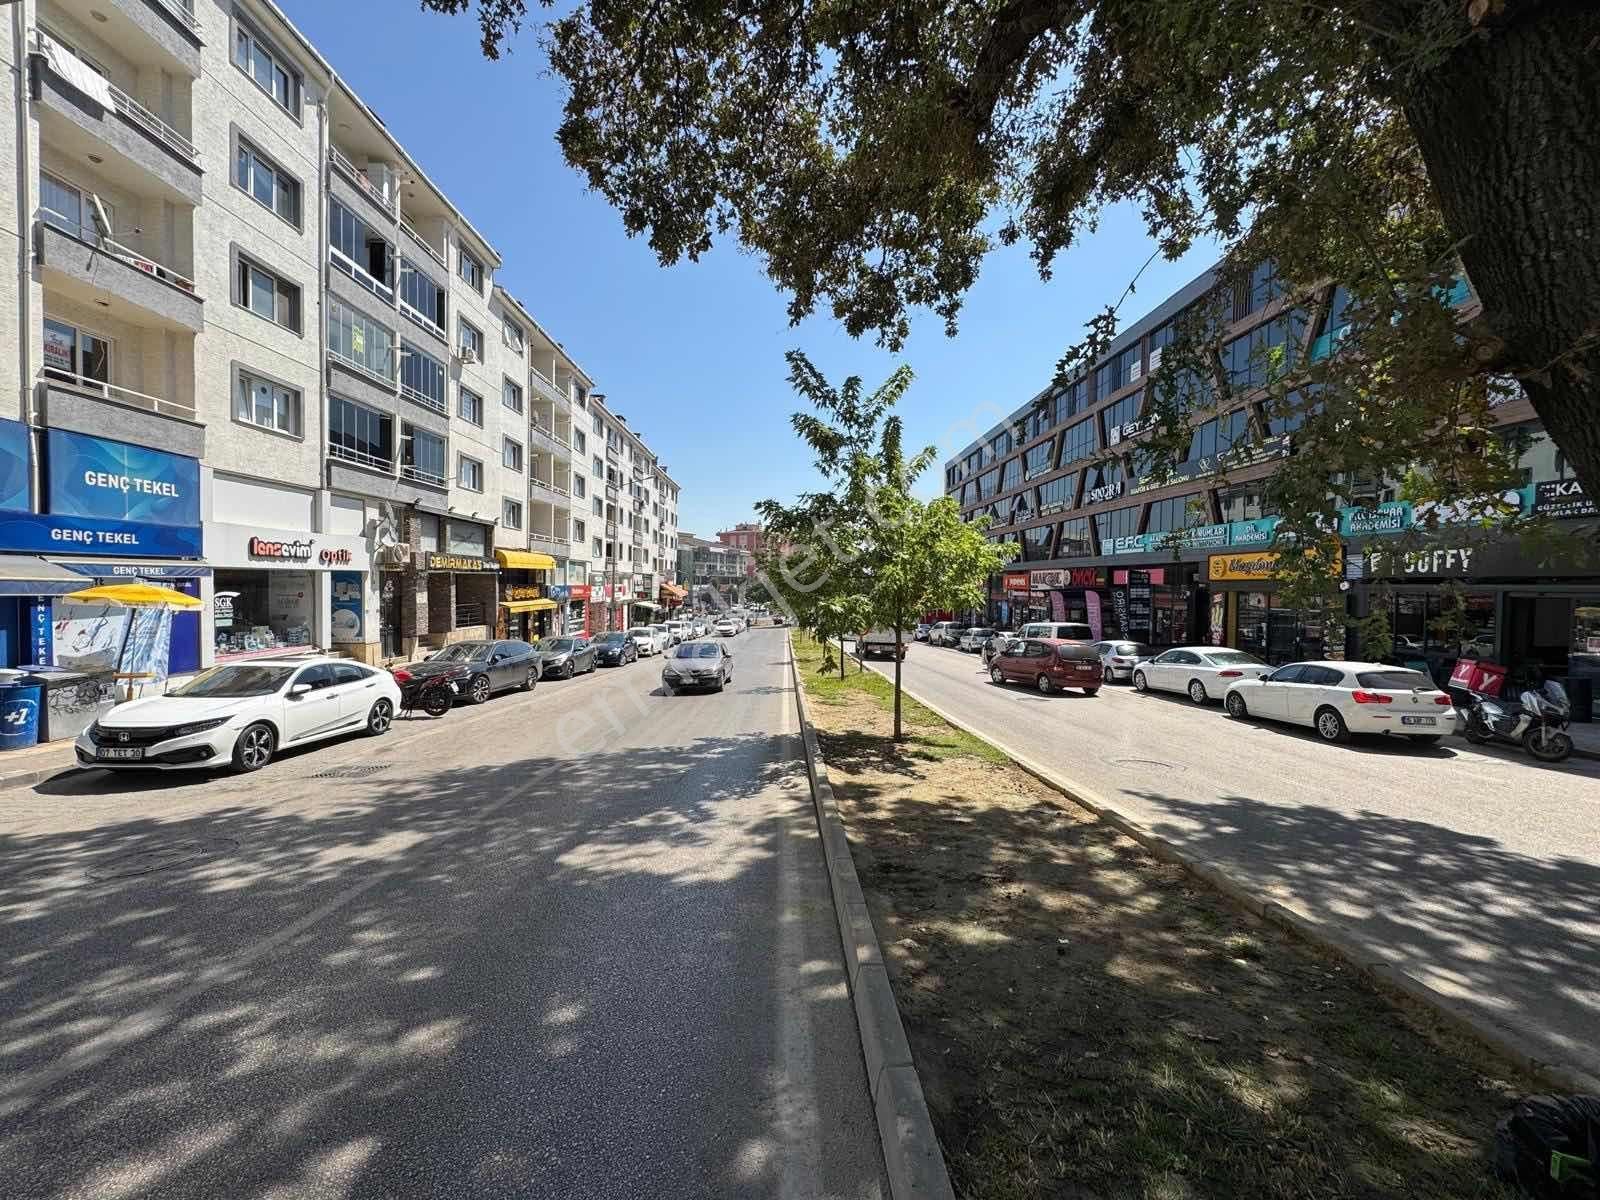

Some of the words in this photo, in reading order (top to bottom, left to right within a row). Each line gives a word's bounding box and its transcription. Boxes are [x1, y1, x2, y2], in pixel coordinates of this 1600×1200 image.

[84, 471, 130, 493] GENÇ
[133, 478, 179, 497] TEKEL
[51, 528, 93, 545] GENÇ
[96, 531, 139, 545] TEKEL
[113, 565, 136, 577] GENÇ
[138, 566, 166, 576] TEKEL
[214, 597, 233, 608] SGK
[38, 627, 46, 665] TEKE
[4, 708, 29, 725] +1
